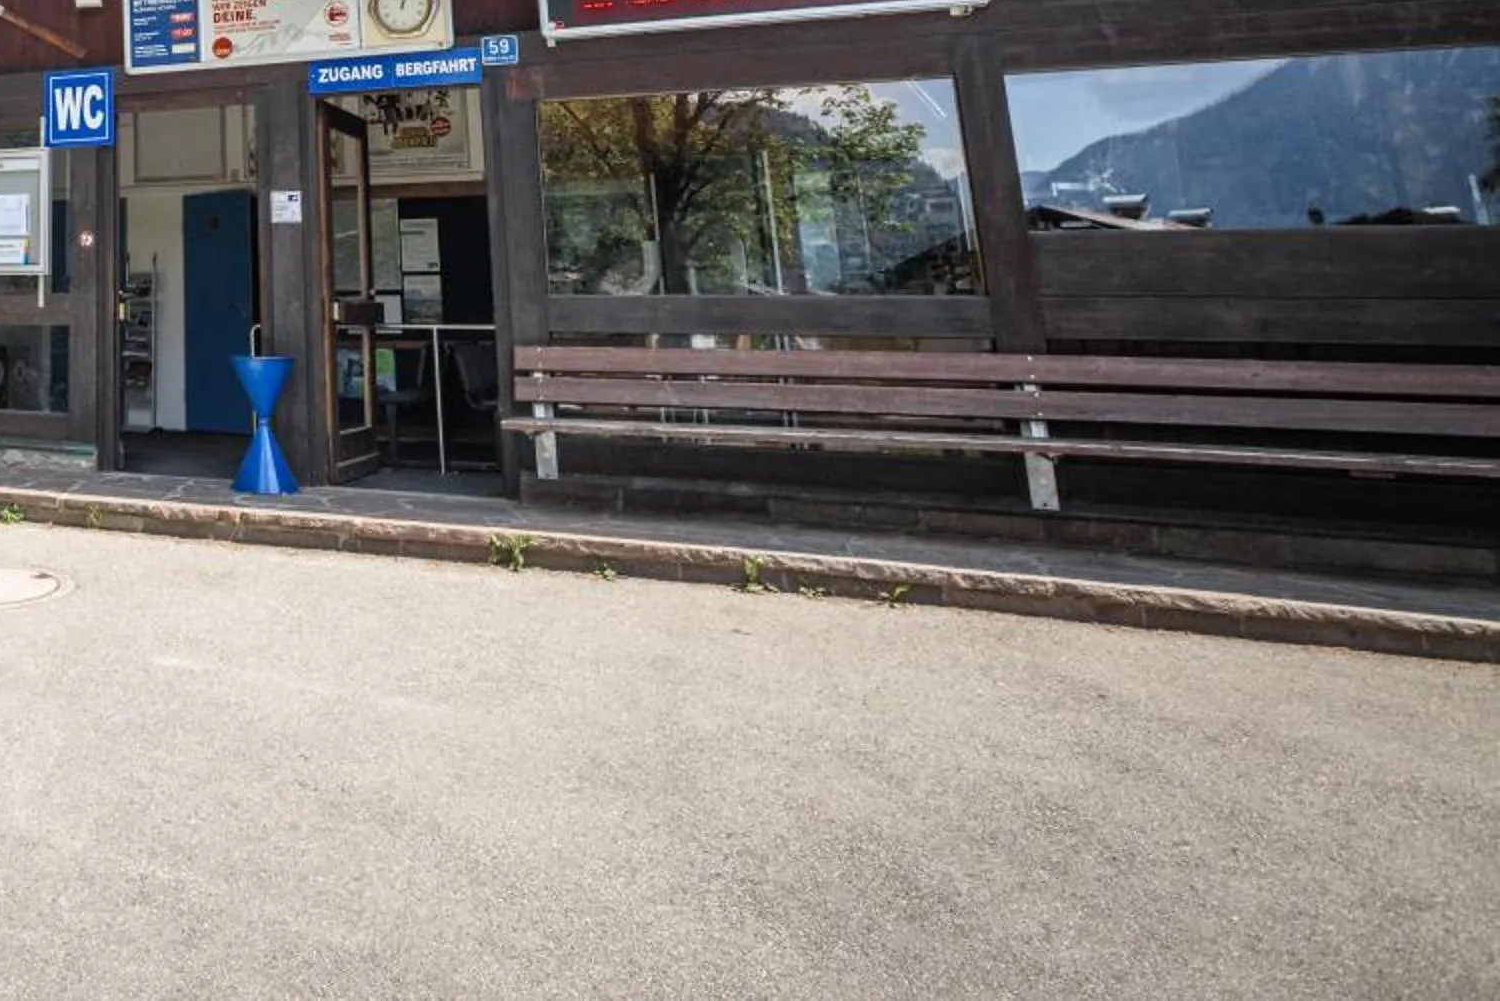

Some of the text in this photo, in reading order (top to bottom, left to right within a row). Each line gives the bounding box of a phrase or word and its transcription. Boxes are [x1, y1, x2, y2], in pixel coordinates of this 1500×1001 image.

[489, 38, 509, 55] 59
[318, 58, 477, 84] ZUGANG BERGFAHRT
[53, 83, 105, 131] WC
